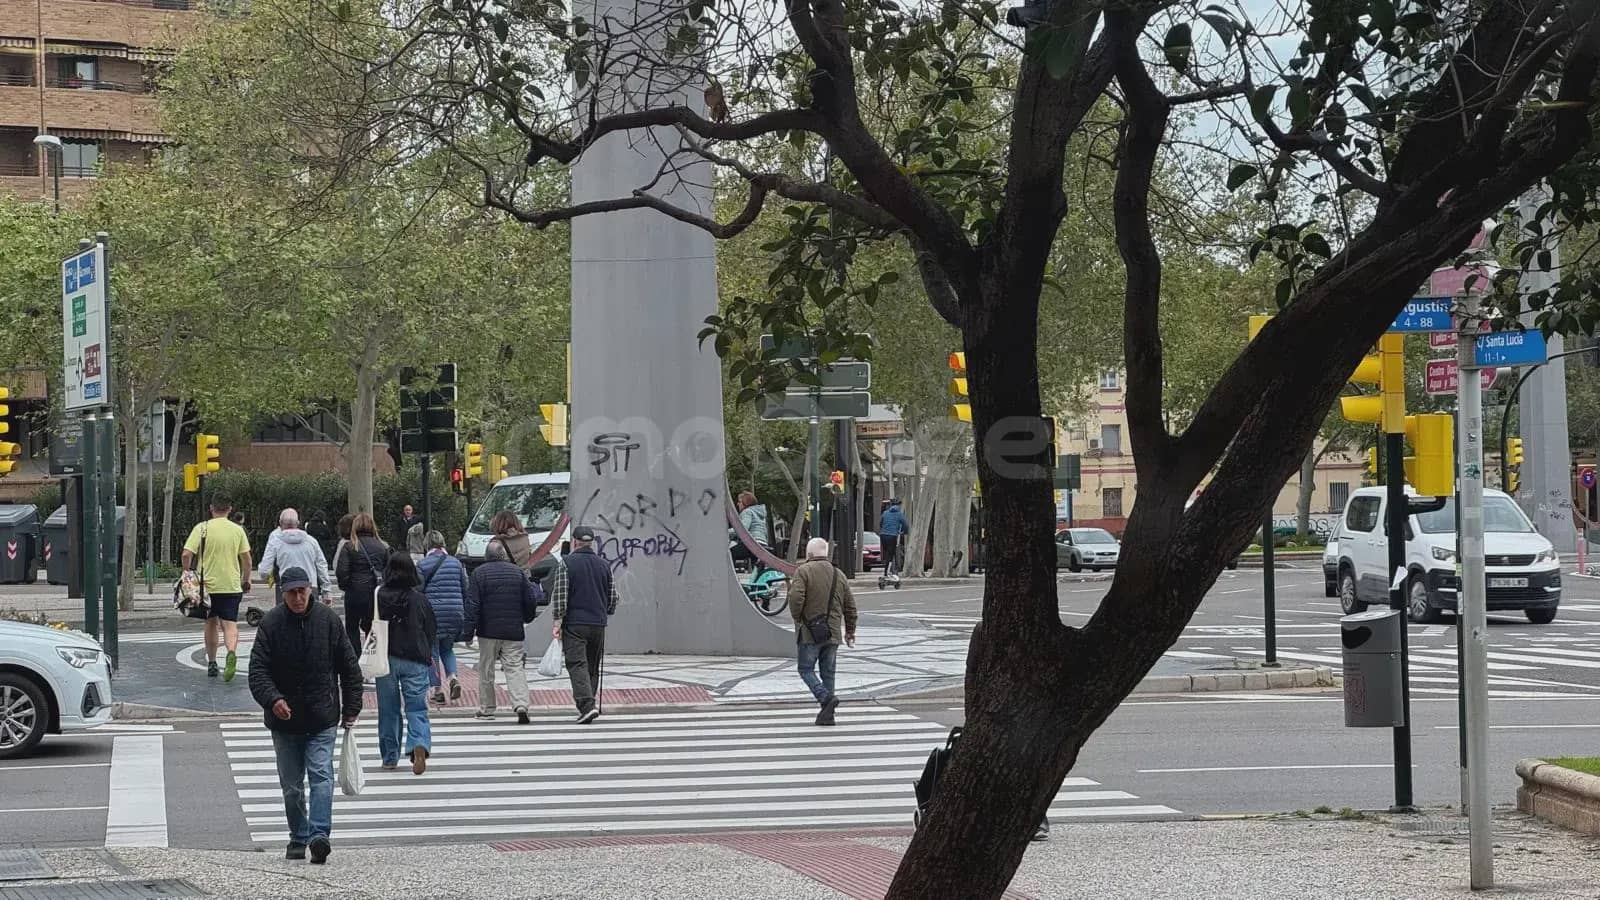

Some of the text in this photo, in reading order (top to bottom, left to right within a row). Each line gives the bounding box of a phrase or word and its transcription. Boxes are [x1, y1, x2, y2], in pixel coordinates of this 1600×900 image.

[1404, 317, 1410, 327] 4
[1420, 317, 1433, 328] 88
[1486, 335, 1505, 348] Santa
